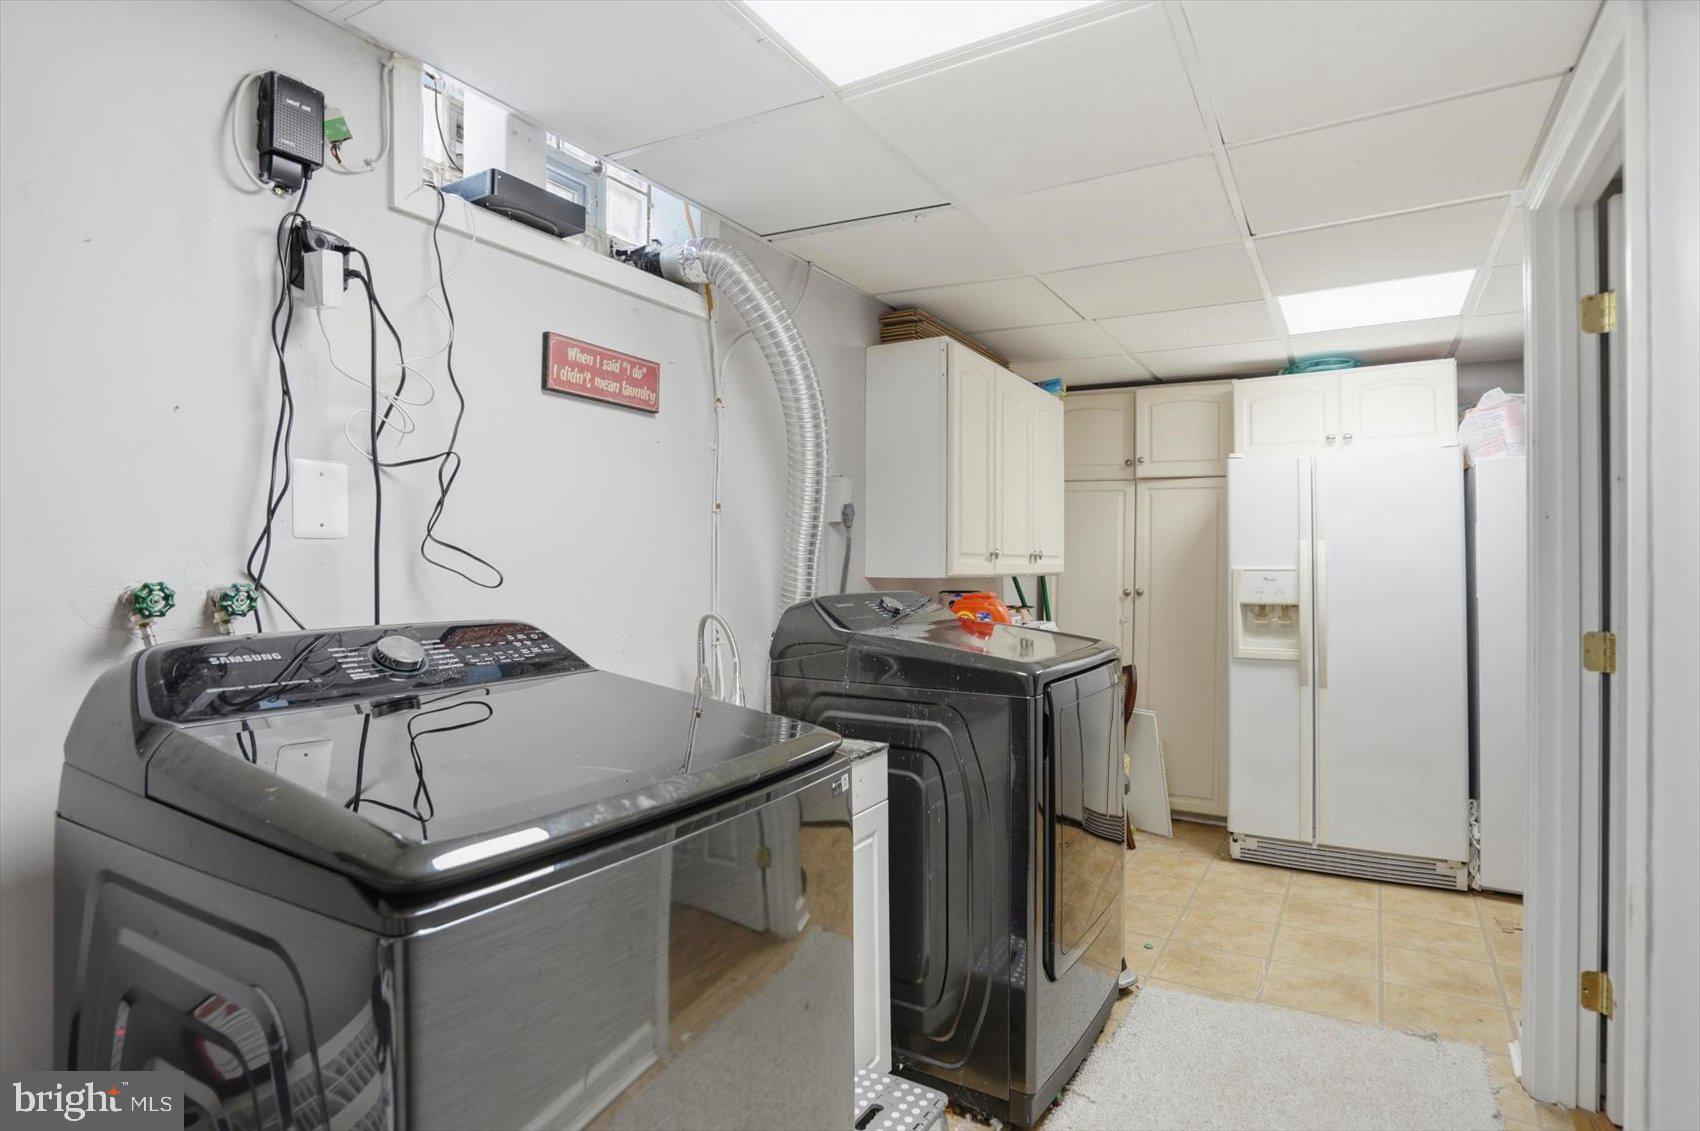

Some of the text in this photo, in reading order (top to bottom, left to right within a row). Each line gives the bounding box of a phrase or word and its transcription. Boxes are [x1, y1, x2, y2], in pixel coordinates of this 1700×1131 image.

[567, 347, 593, 366] When
[596, 355, 600, 368] I
[603, 359, 620, 373] said
[553, 364, 656, 405] I didn't mean laundry
[209, 653, 282, 664] SAMSUNG
